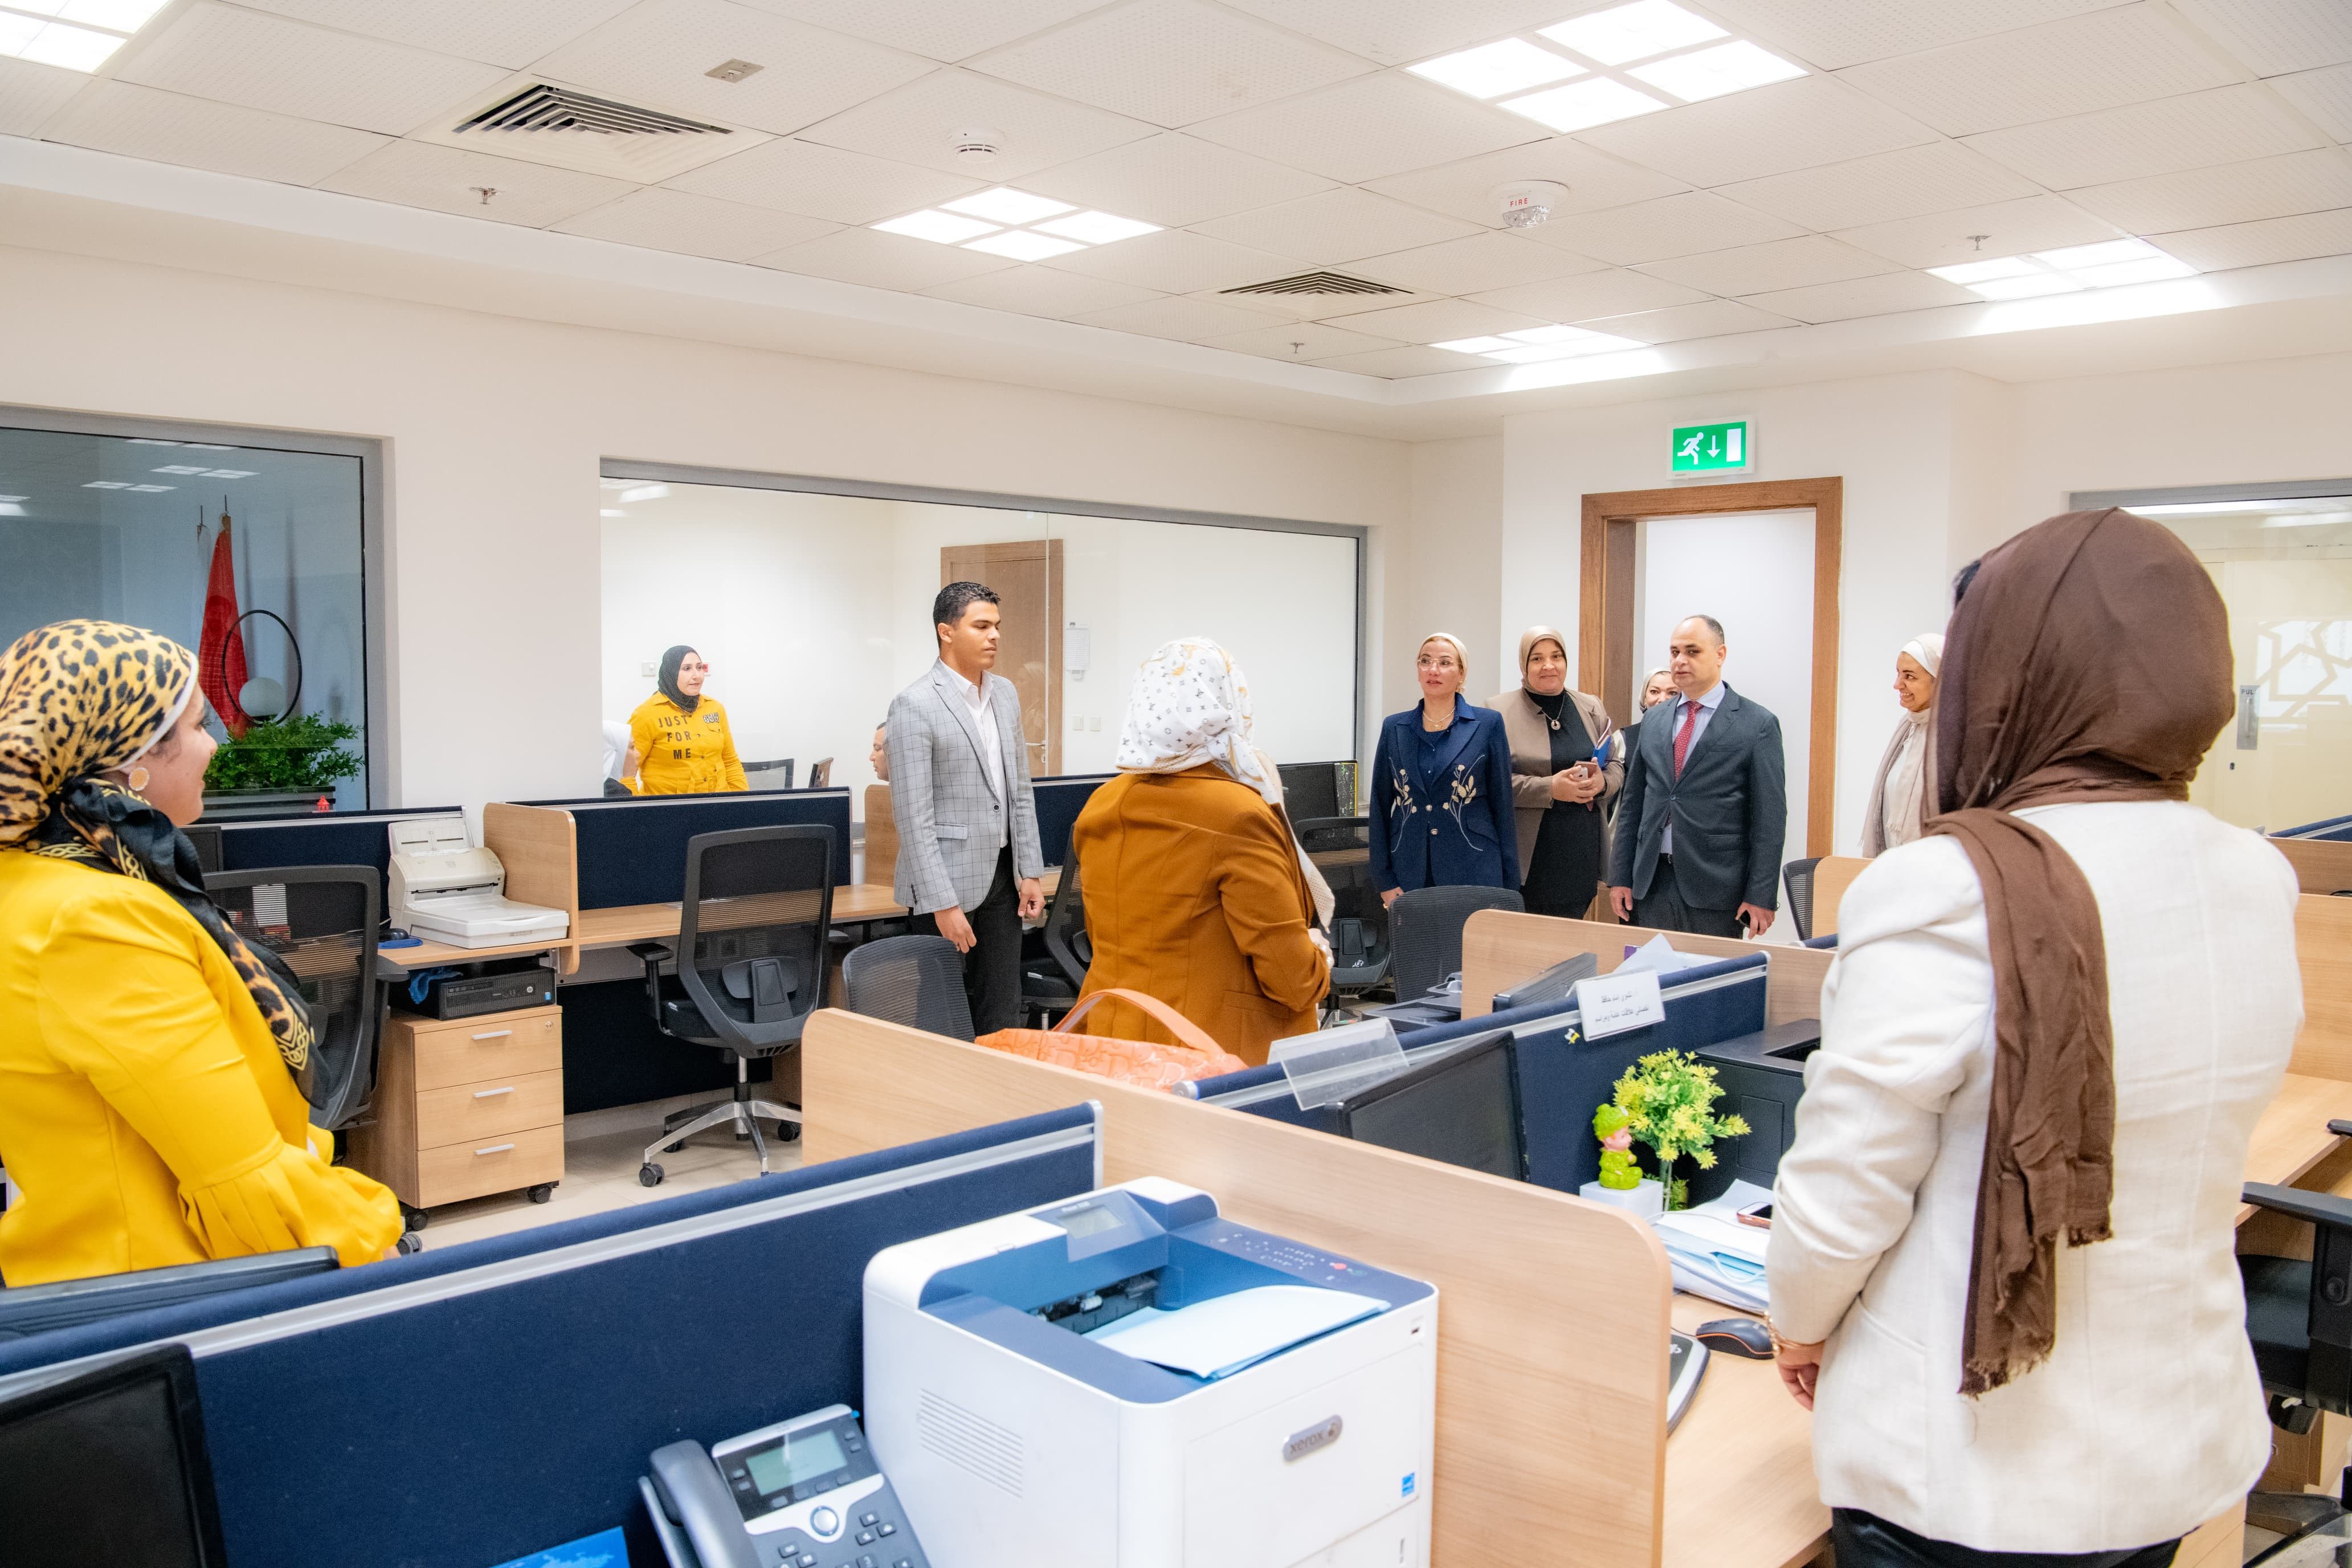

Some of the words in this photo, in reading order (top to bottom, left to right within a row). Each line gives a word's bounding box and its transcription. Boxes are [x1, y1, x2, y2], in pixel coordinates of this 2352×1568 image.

[1510, 198, 1528, 207] FIRE
[658, 714, 688, 728] JUST
[667, 731, 691, 742] FOR
[673, 748, 691, 760] ME
